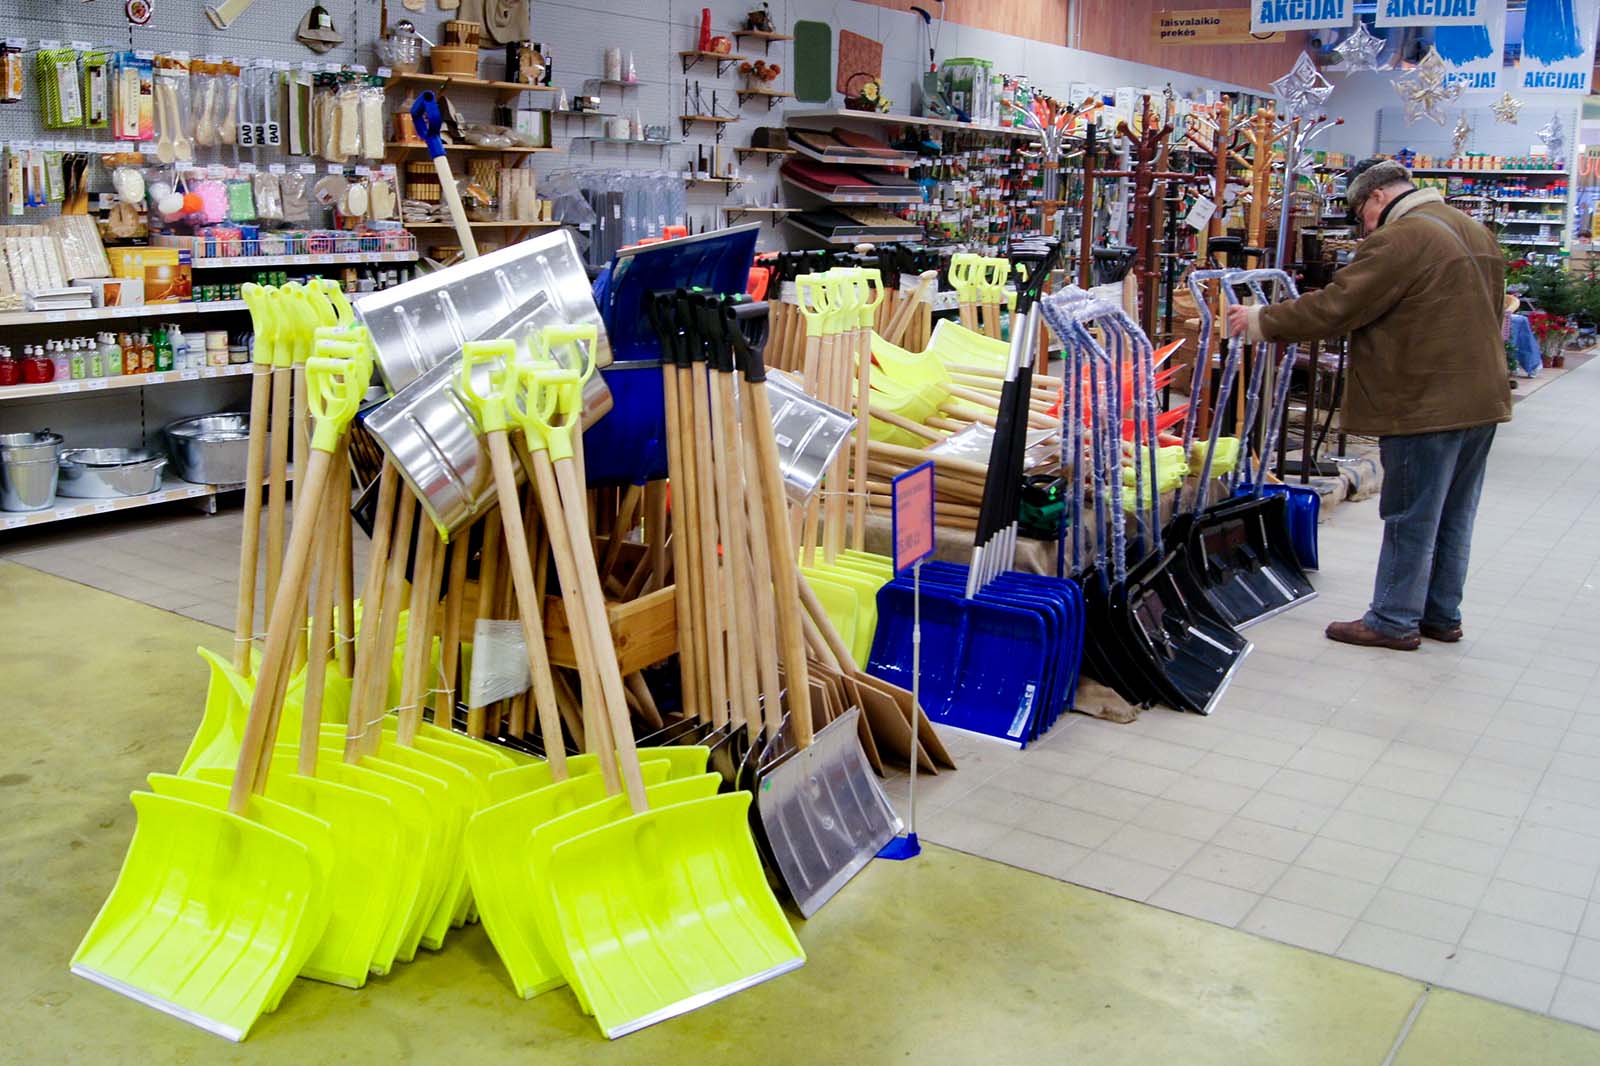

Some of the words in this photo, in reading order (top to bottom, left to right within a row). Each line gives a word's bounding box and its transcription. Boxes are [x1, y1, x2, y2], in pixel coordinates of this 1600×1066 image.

[1260, 0, 1344, 23] AKCIJA!
[1384, 0, 1477, 17] AKCIJA!
[1160, 17, 1220, 27] laisvalaikio
[1524, 72, 1586, 89] AKCIJA!
[242, 125, 252, 144] BAD
[269, 124, 279, 143] BAD
